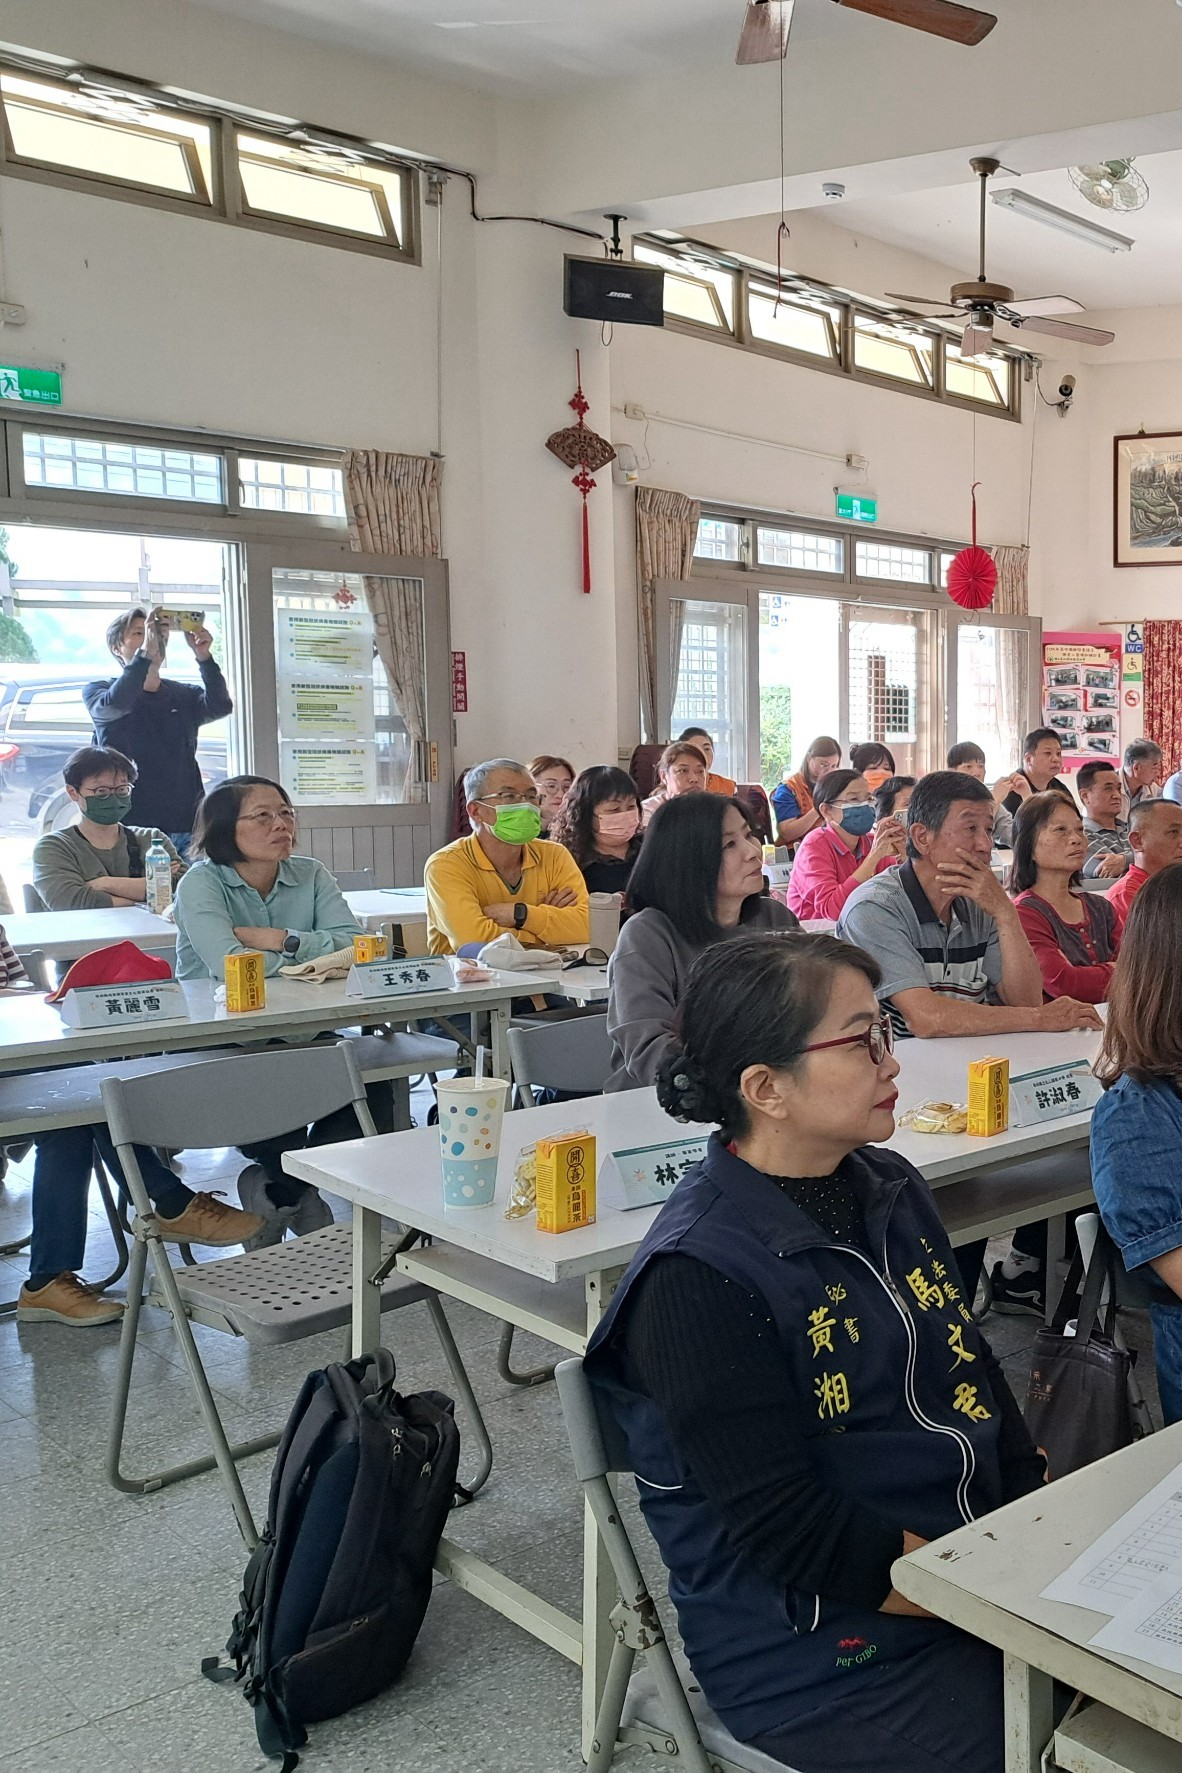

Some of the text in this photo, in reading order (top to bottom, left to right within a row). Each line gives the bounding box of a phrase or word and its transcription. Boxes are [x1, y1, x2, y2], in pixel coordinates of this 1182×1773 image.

[382, 969, 431, 987] 王秀春
[105, 996, 160, 1015] 黃麗雪
[1035, 1082, 1081, 1110] 許淑春
[572, 1192, 581, 1222] 烏龍茶
[824, 1282, 860, 1344] 秘書
